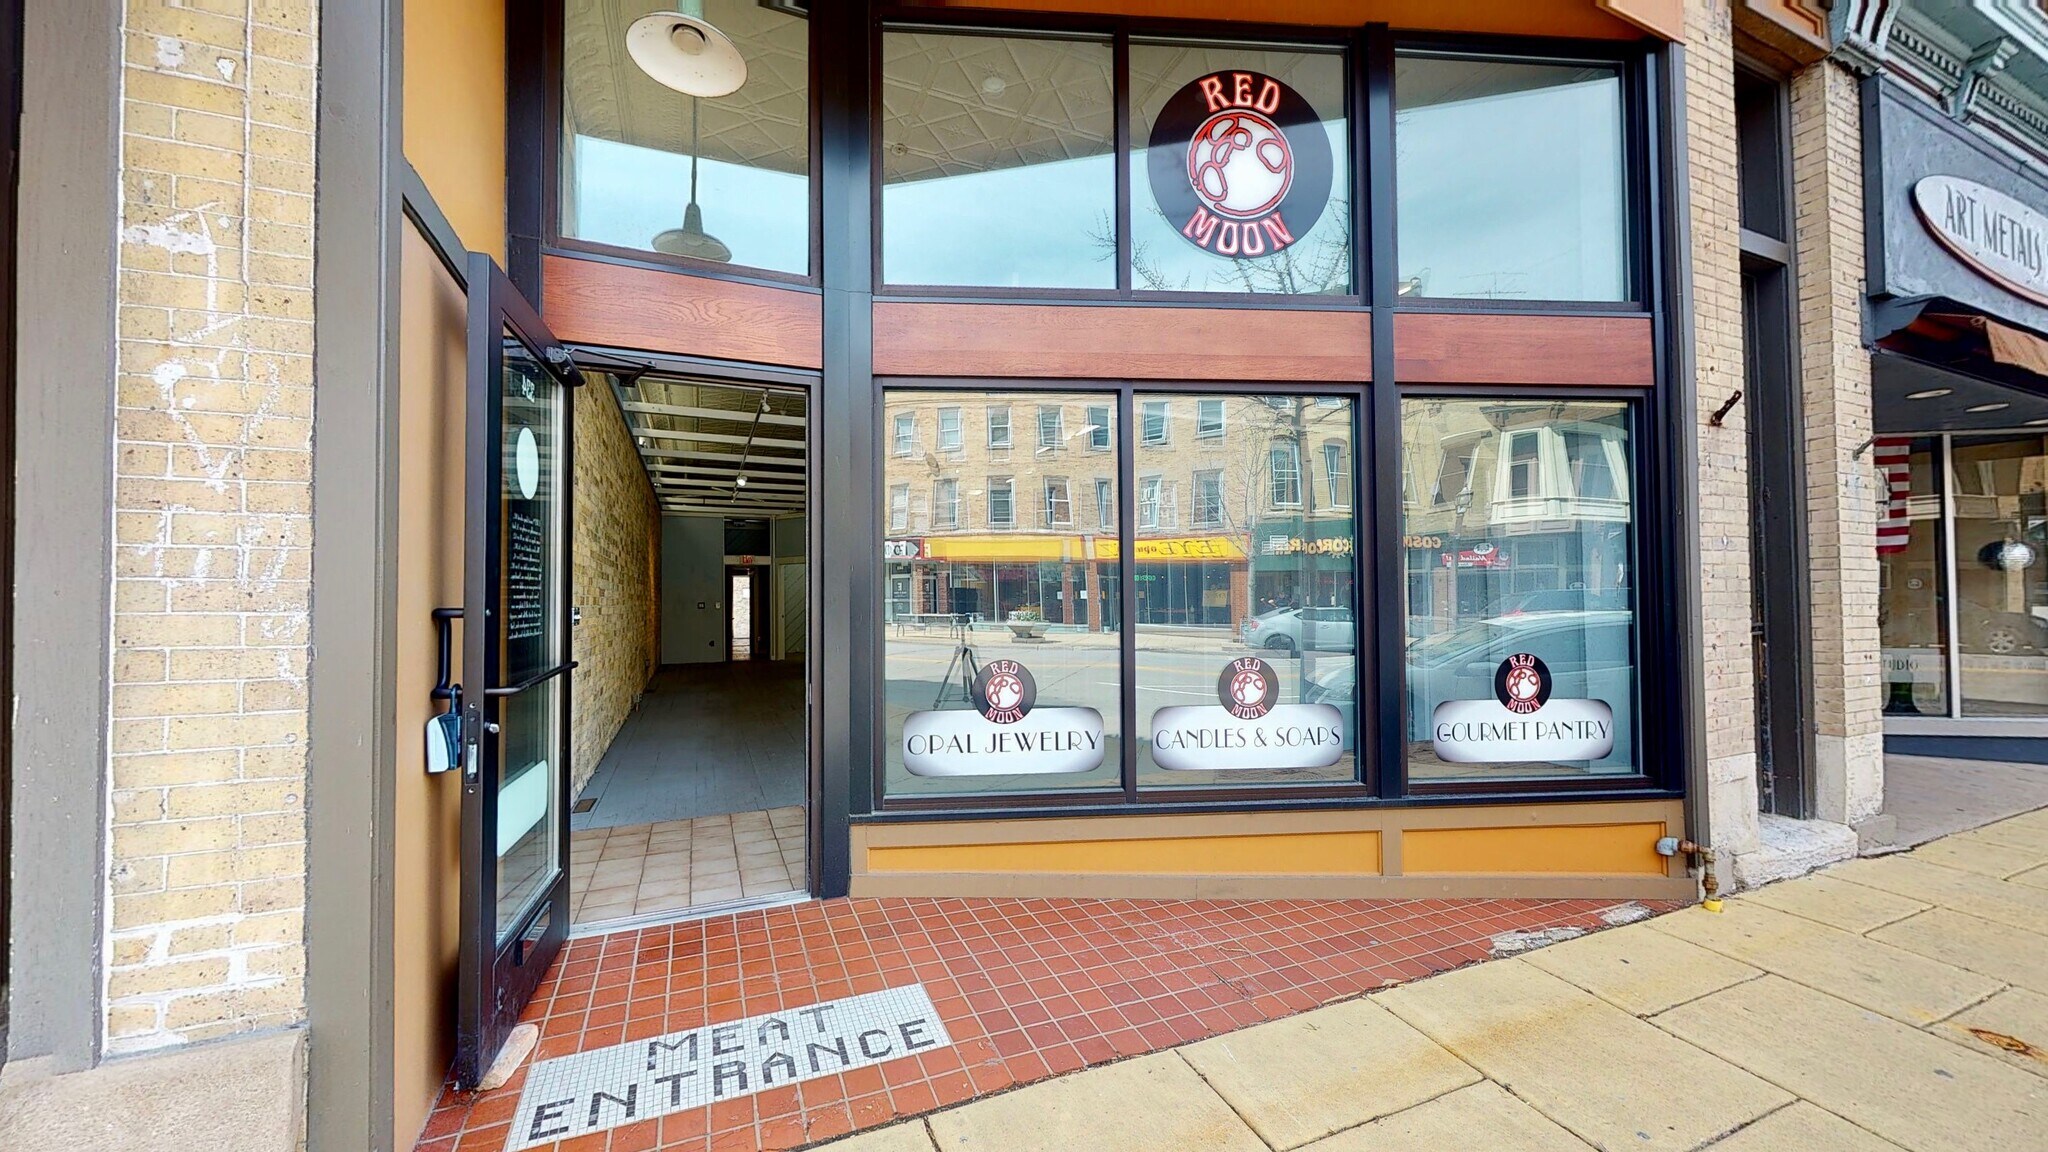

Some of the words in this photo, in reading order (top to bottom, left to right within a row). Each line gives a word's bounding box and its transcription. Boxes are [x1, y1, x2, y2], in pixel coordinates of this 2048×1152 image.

[1199, 73, 1280, 114] RED
[1183, 205, 1295, 256] MOON
[1944, 184, 1977, 243] ART
[1983, 203, 2042, 278] METALS
[990, 660, 1018, 675] RED
[1233, 658, 1261, 672] RED
[1508, 653, 1535, 667] RED
[985, 709, 1024, 724] MOON
[1231, 704, 1268, 719] MOON
[1506, 698, 1542, 713] MOON
[907, 733, 978, 756] OPAL
[985, 730, 1101, 754] JEWELRY
[1155, 727, 1247, 750] CANDLES
[1254, 727, 1268, 747] &
[1274, 725, 1341, 747] SOAPS
[1436, 721, 1530, 743] GOURMET
[1535, 720, 1610, 741] PANTRY
[647, 1004, 834, 1071] MEAT
[528, 1018, 935, 1141] ENTRANCE
